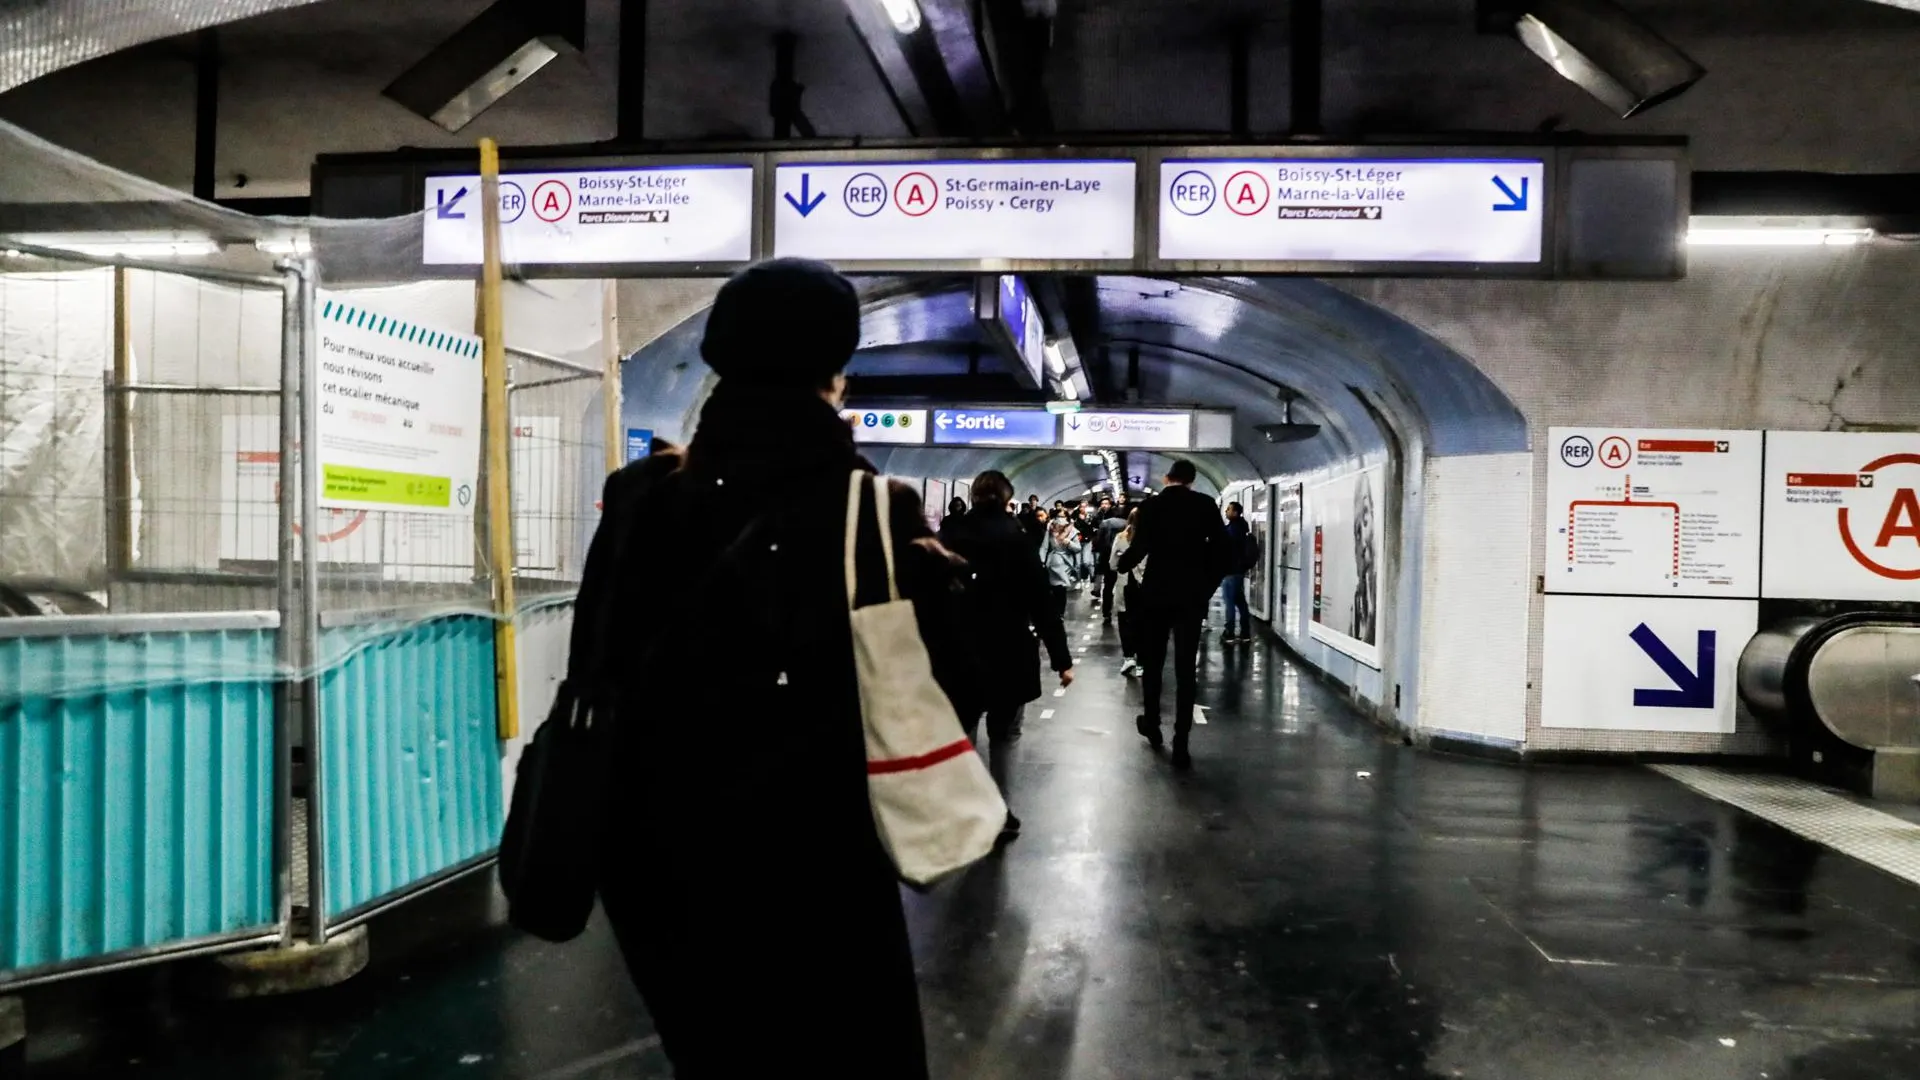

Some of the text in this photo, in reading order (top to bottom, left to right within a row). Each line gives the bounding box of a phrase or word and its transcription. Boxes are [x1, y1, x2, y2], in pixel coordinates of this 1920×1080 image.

[579, 175, 687, 191] Boissy-St-Léger
[1279, 168, 1402, 185] Boissy-St-Léger
[849, 184, 925, 205] RER A
[946, 178, 1101, 198] St-Germain-en-Laye
[1176, 183, 1256, 204] RER A
[1278, 187, 1406, 201] Marne-la-Vallée
[499, 191, 560, 212] ER A
[578, 191, 690, 206] Marne-la-Vallée
[945, 196, 1054, 212] Poissy Cergy
[580, 211, 651, 223] Parcs Disneyland
[1280, 208, 1360, 220] Parcs Disneyland
[323, 336, 435, 375] Pour mieux vous accueillir
[323, 362, 383, 384] nous révisons
[322, 382, 420, 412] cet escalier mécanique
[323, 401, 413, 429] du au
[867, 415, 875, 425] 2
[884, 415, 892, 425] 6
[902, 416, 909, 426] 9
[956, 414, 1005, 430] Sortie
[1565, 446, 1589, 458] RER
[1607, 445, 1622, 460] A
[1874, 488, 1920, 547] A
